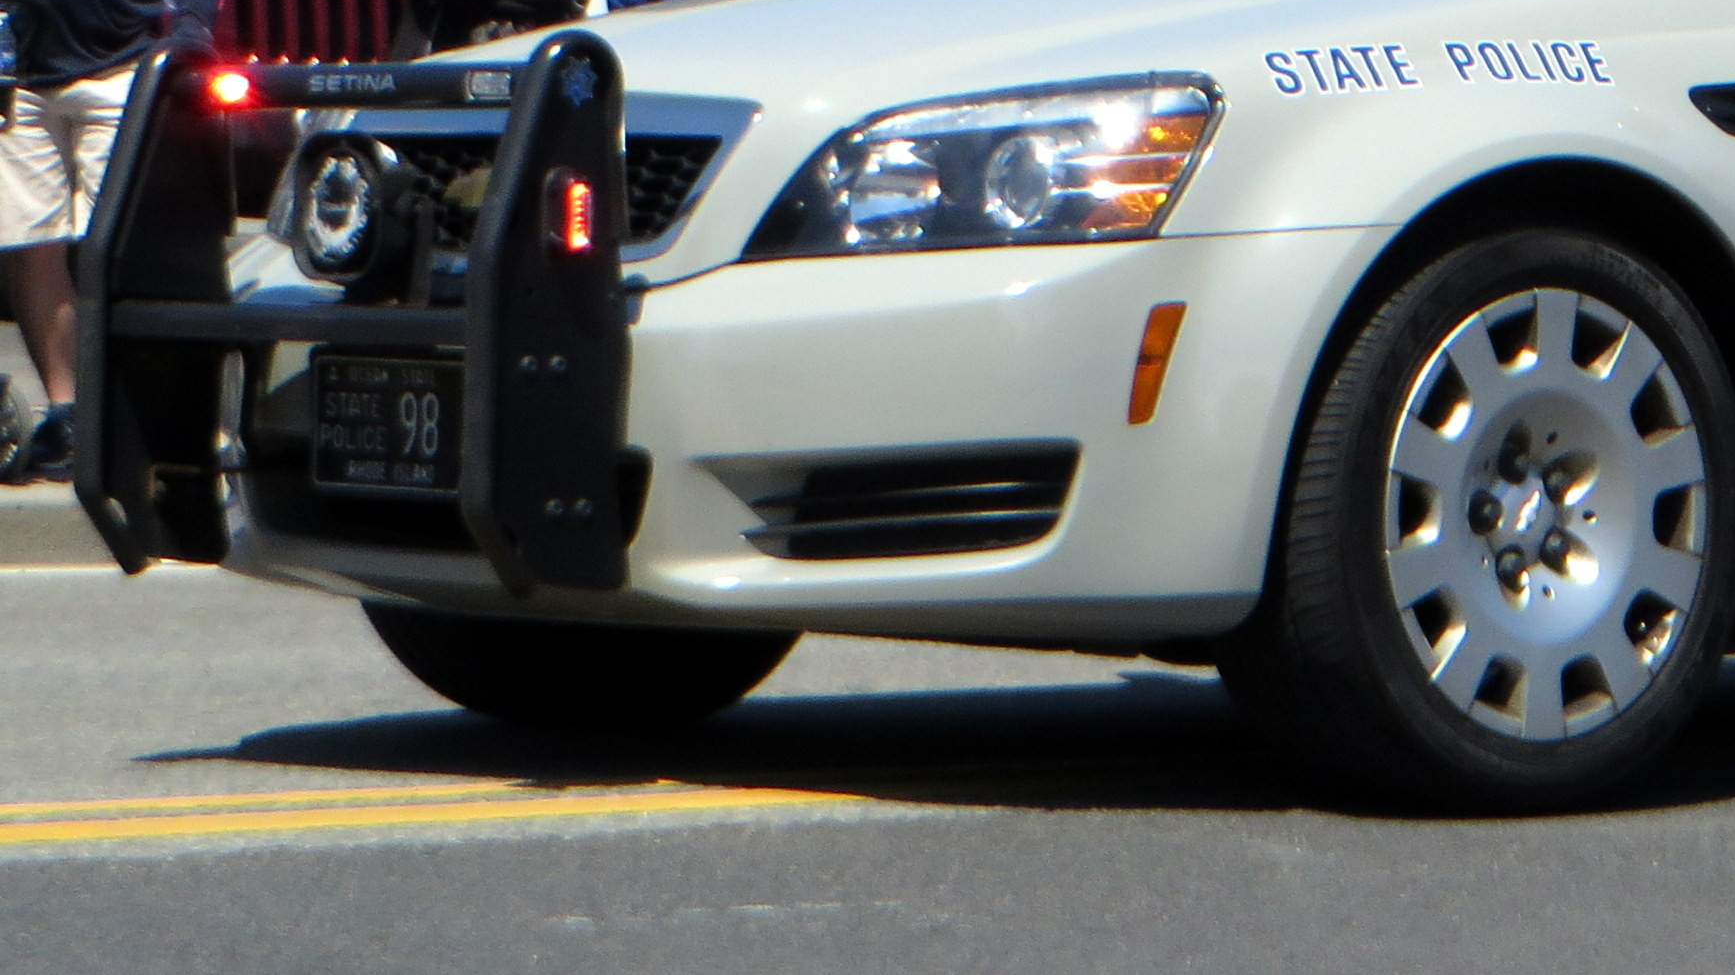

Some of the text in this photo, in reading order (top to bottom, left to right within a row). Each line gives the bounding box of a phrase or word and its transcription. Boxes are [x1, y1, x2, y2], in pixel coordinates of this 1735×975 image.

[1264, 41, 1613, 94] STATE POLICE
[309, 74, 397, 93] SETINA
[325, 392, 381, 419] STATE
[319, 423, 388, 451] POLICE
[399, 391, 440, 456] 98
